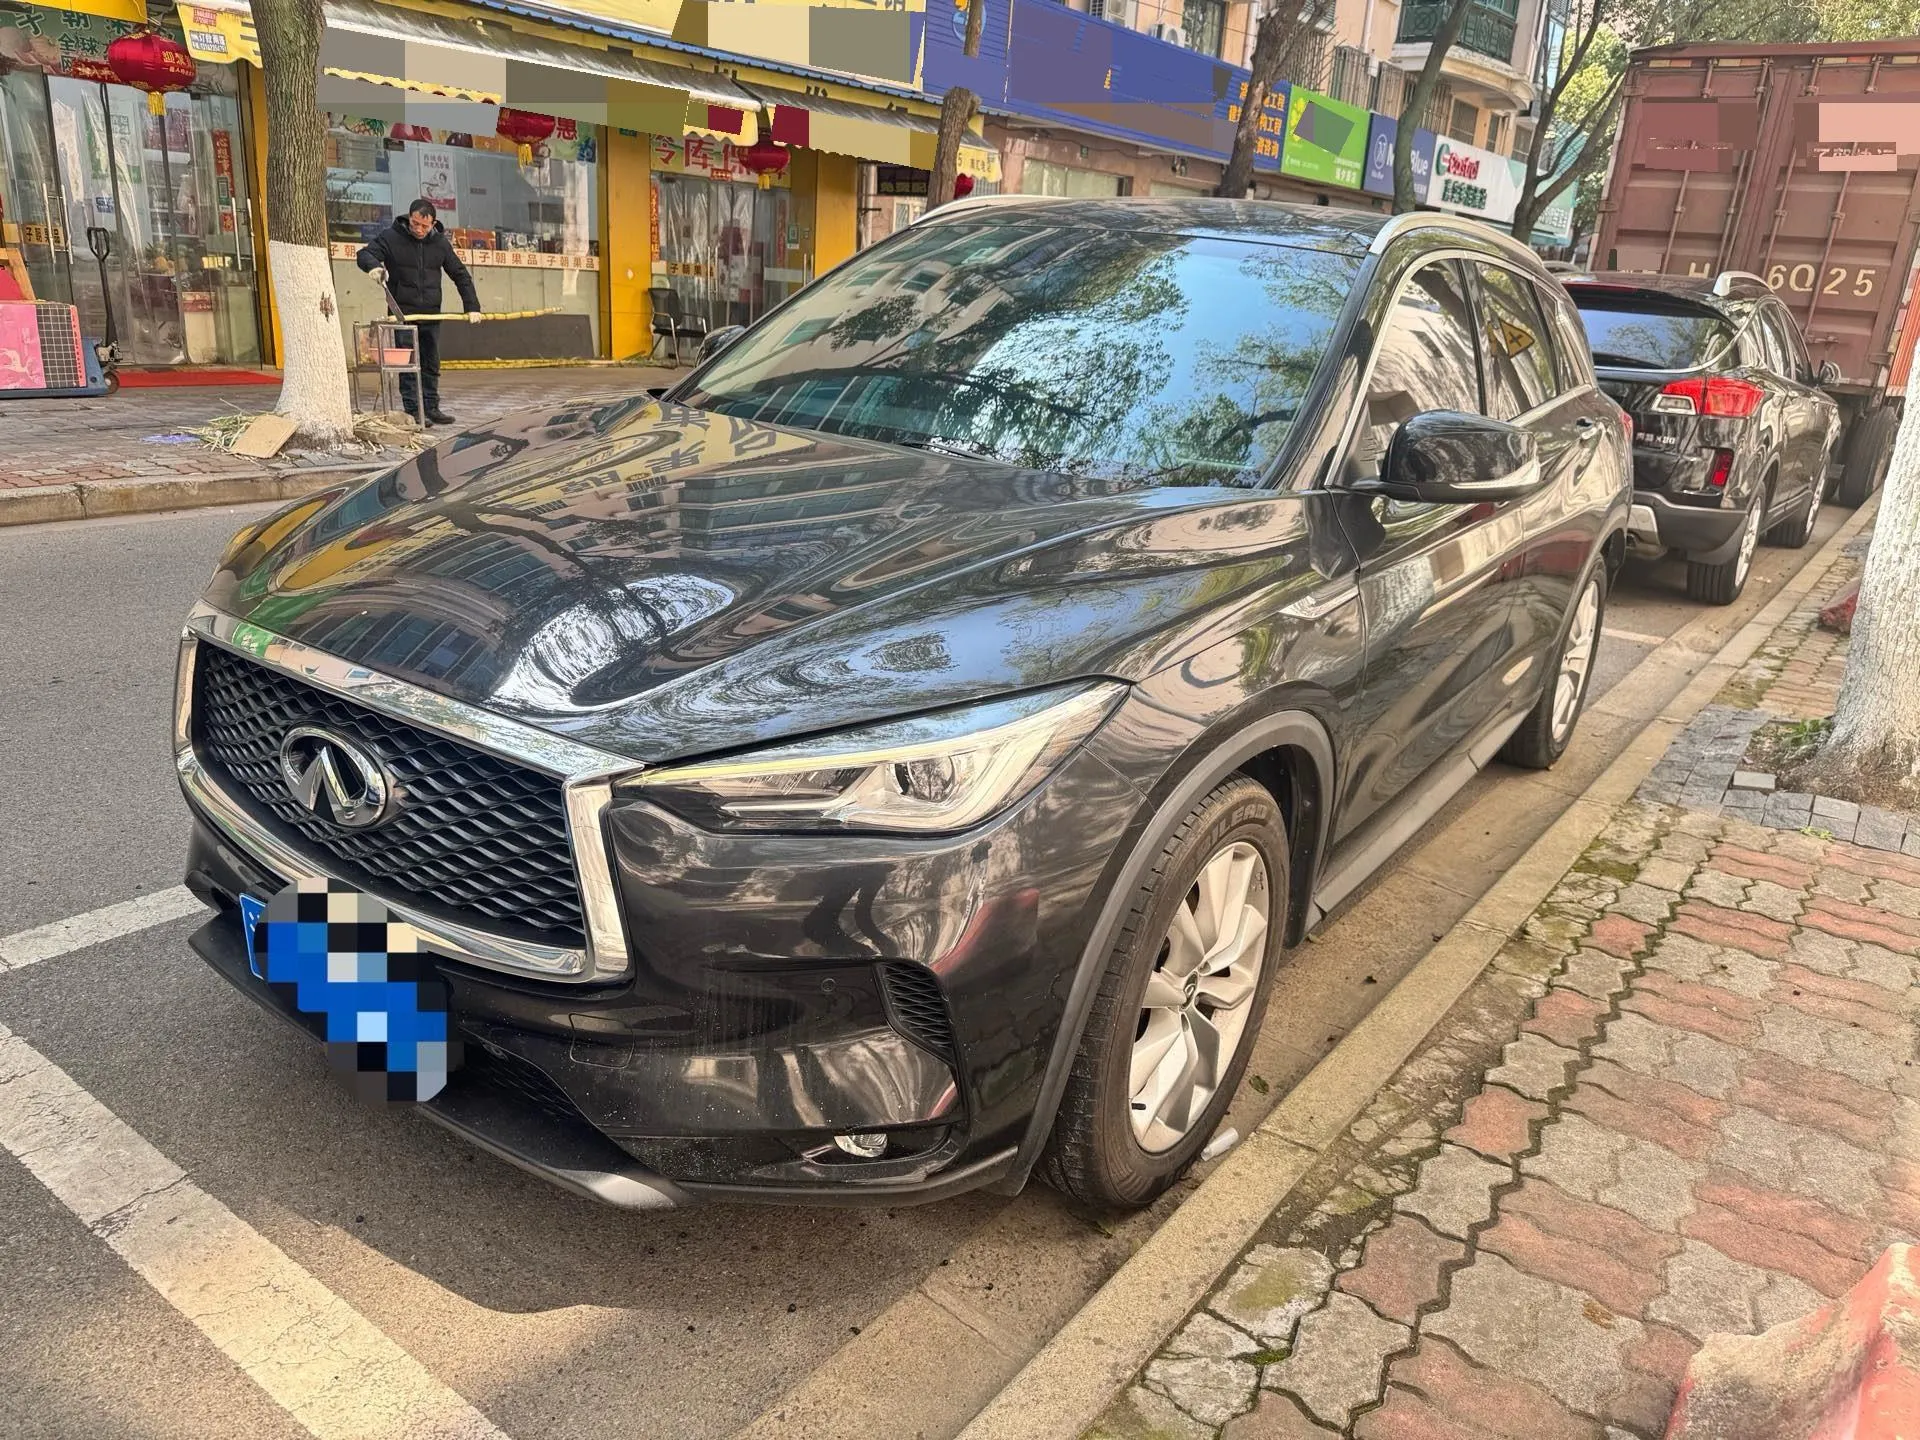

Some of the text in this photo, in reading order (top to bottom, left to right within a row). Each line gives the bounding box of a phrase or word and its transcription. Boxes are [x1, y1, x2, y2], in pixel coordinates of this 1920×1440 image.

[479, 251, 538, 266] 子朝果品
[546, 255, 595, 269] 子朝果品
